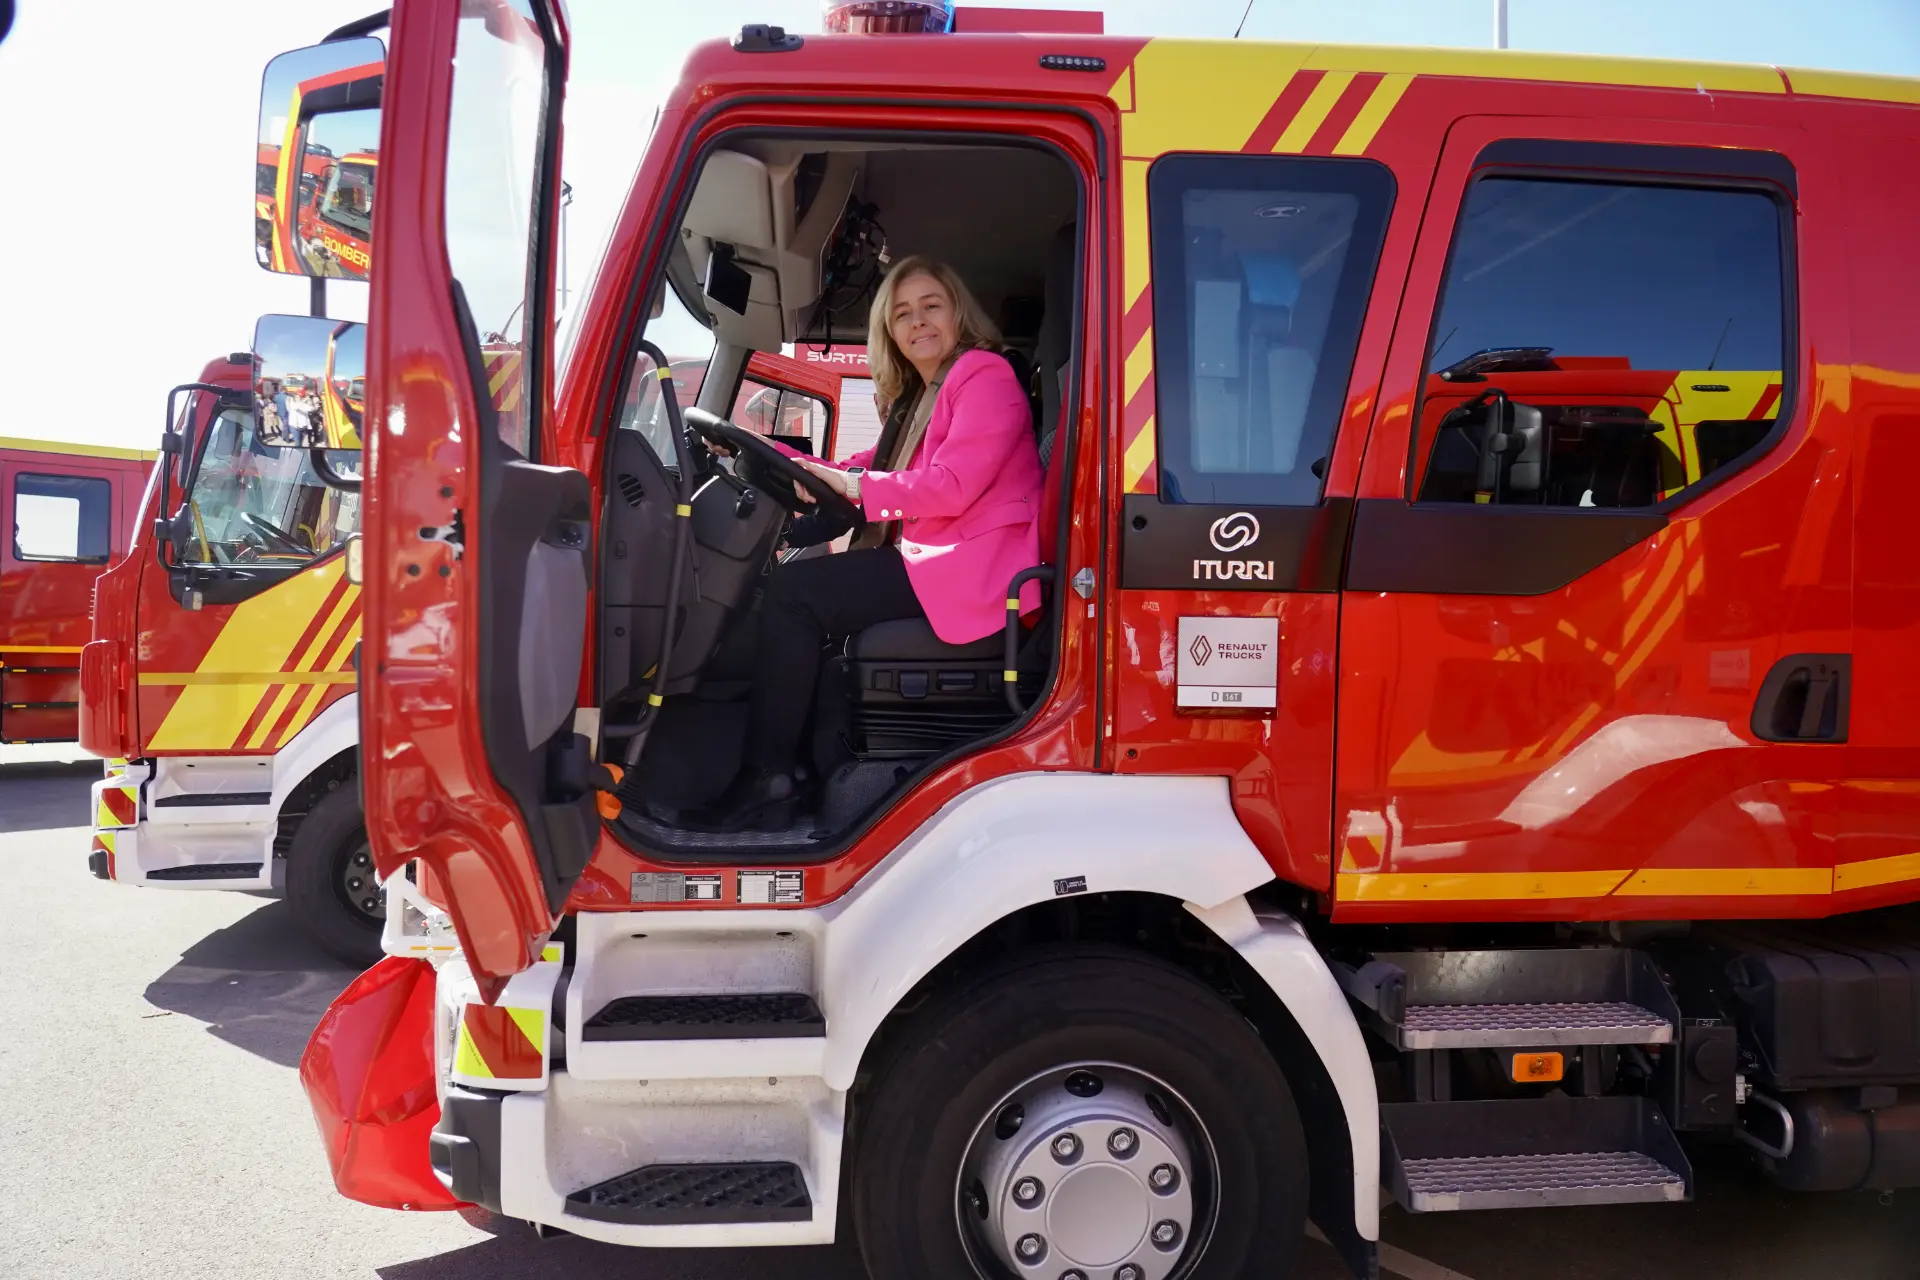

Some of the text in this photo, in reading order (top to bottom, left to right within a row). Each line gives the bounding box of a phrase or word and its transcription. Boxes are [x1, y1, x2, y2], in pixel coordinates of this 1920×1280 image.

[324, 236, 370, 269] BOMBER
[807, 351, 869, 364] SURTR
[1193, 559, 1275, 580] ITURRI
[1218, 643, 1267, 651] RENAULT
[1218, 651, 1262, 660] TRUCKS
[1211, 691, 1239, 702] D 16T
